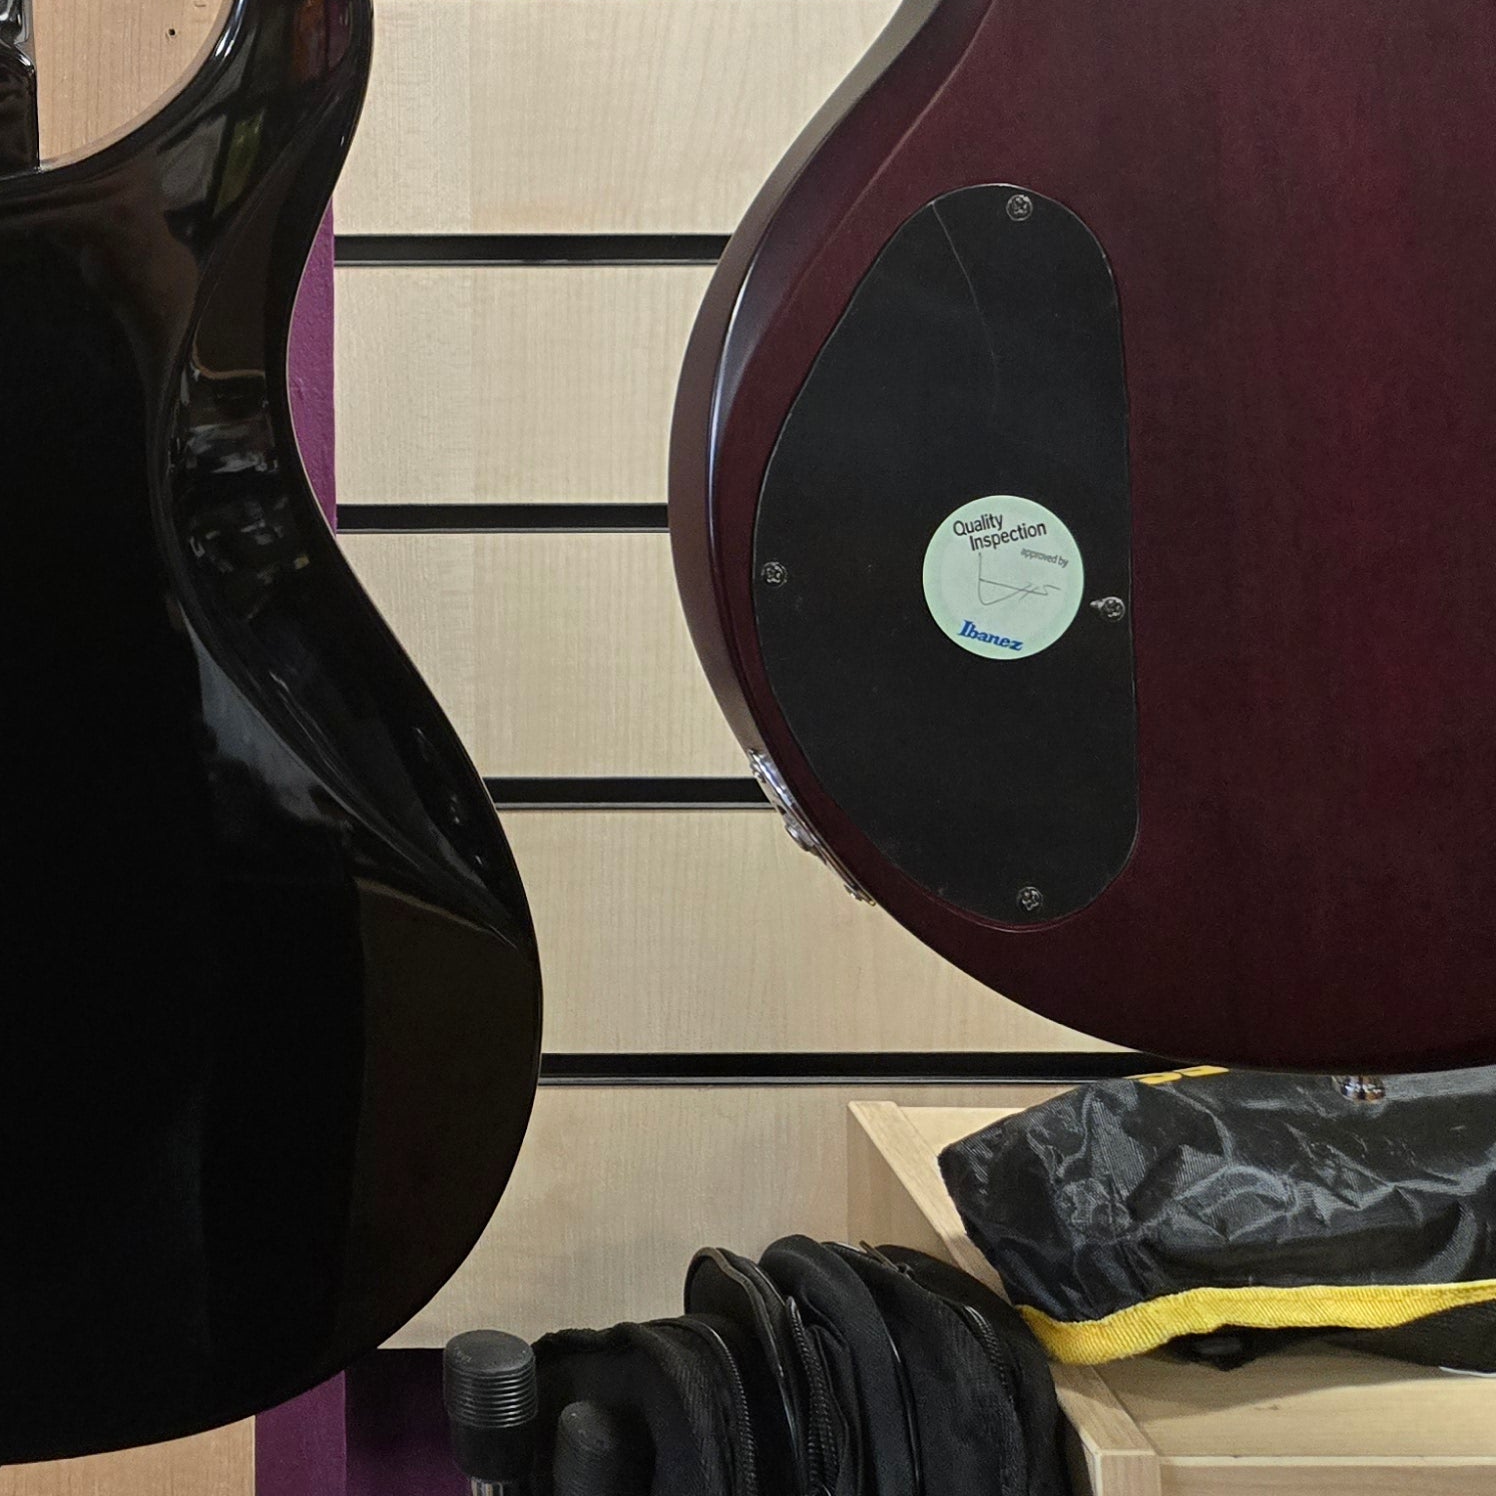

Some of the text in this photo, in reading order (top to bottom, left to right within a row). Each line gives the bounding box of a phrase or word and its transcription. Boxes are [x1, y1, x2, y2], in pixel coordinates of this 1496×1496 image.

[953, 513, 1003, 537] Quality
[969, 523, 1047, 552] Inspection
[1020, 548, 1070, 568] approved by
[957, 619, 1025, 652] Ibanez
